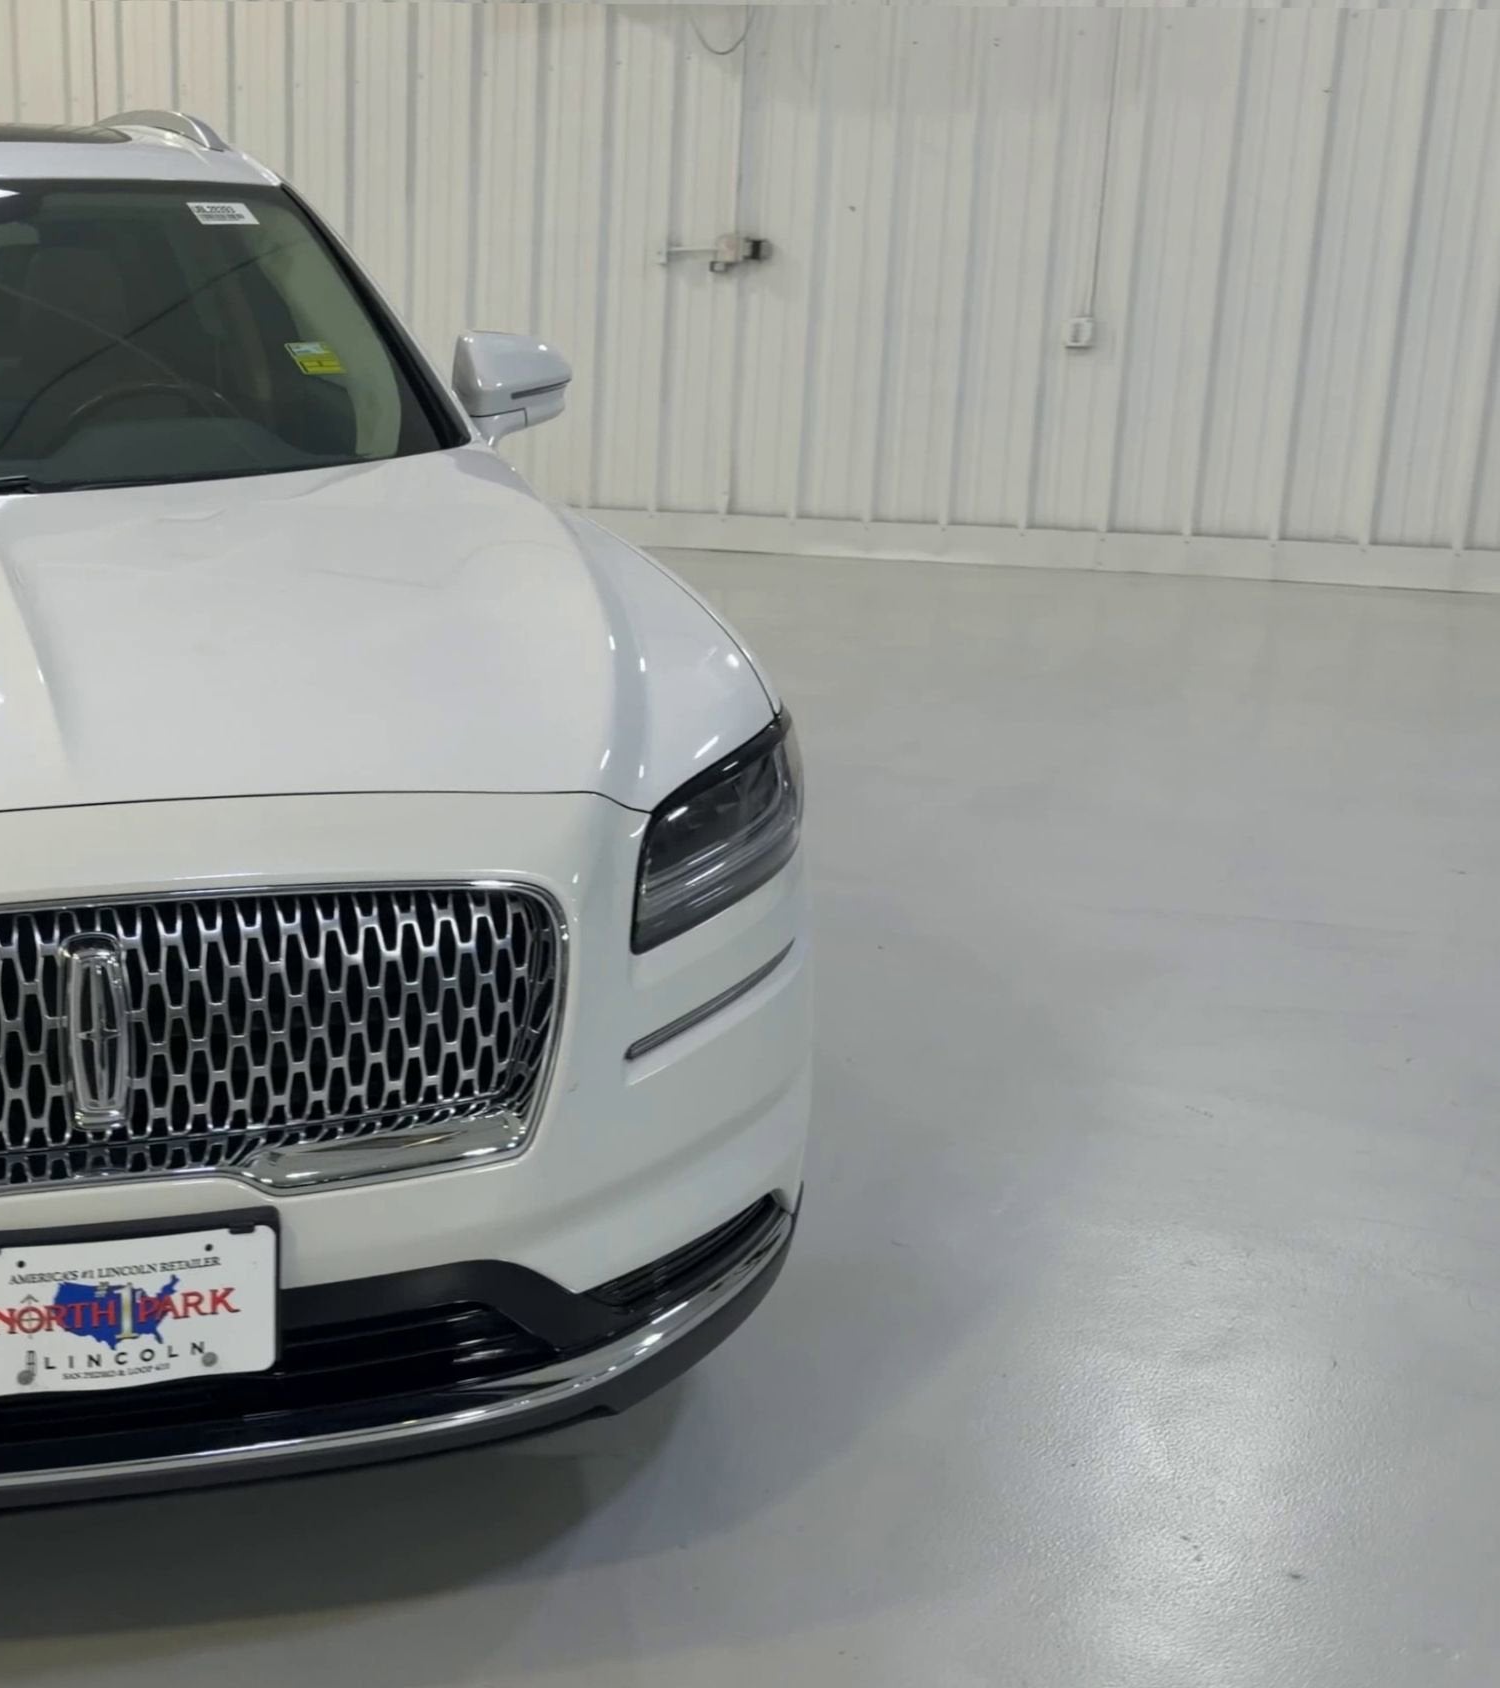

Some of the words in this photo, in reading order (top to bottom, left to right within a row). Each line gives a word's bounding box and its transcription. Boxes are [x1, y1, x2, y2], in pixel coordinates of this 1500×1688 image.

[97, 1262, 158, 1278] LINCOLN
[159, 1256, 222, 1273] RETAILER
[137, 1287, 241, 1324] PARK
[43, 1341, 205, 1370] LINCOLN
